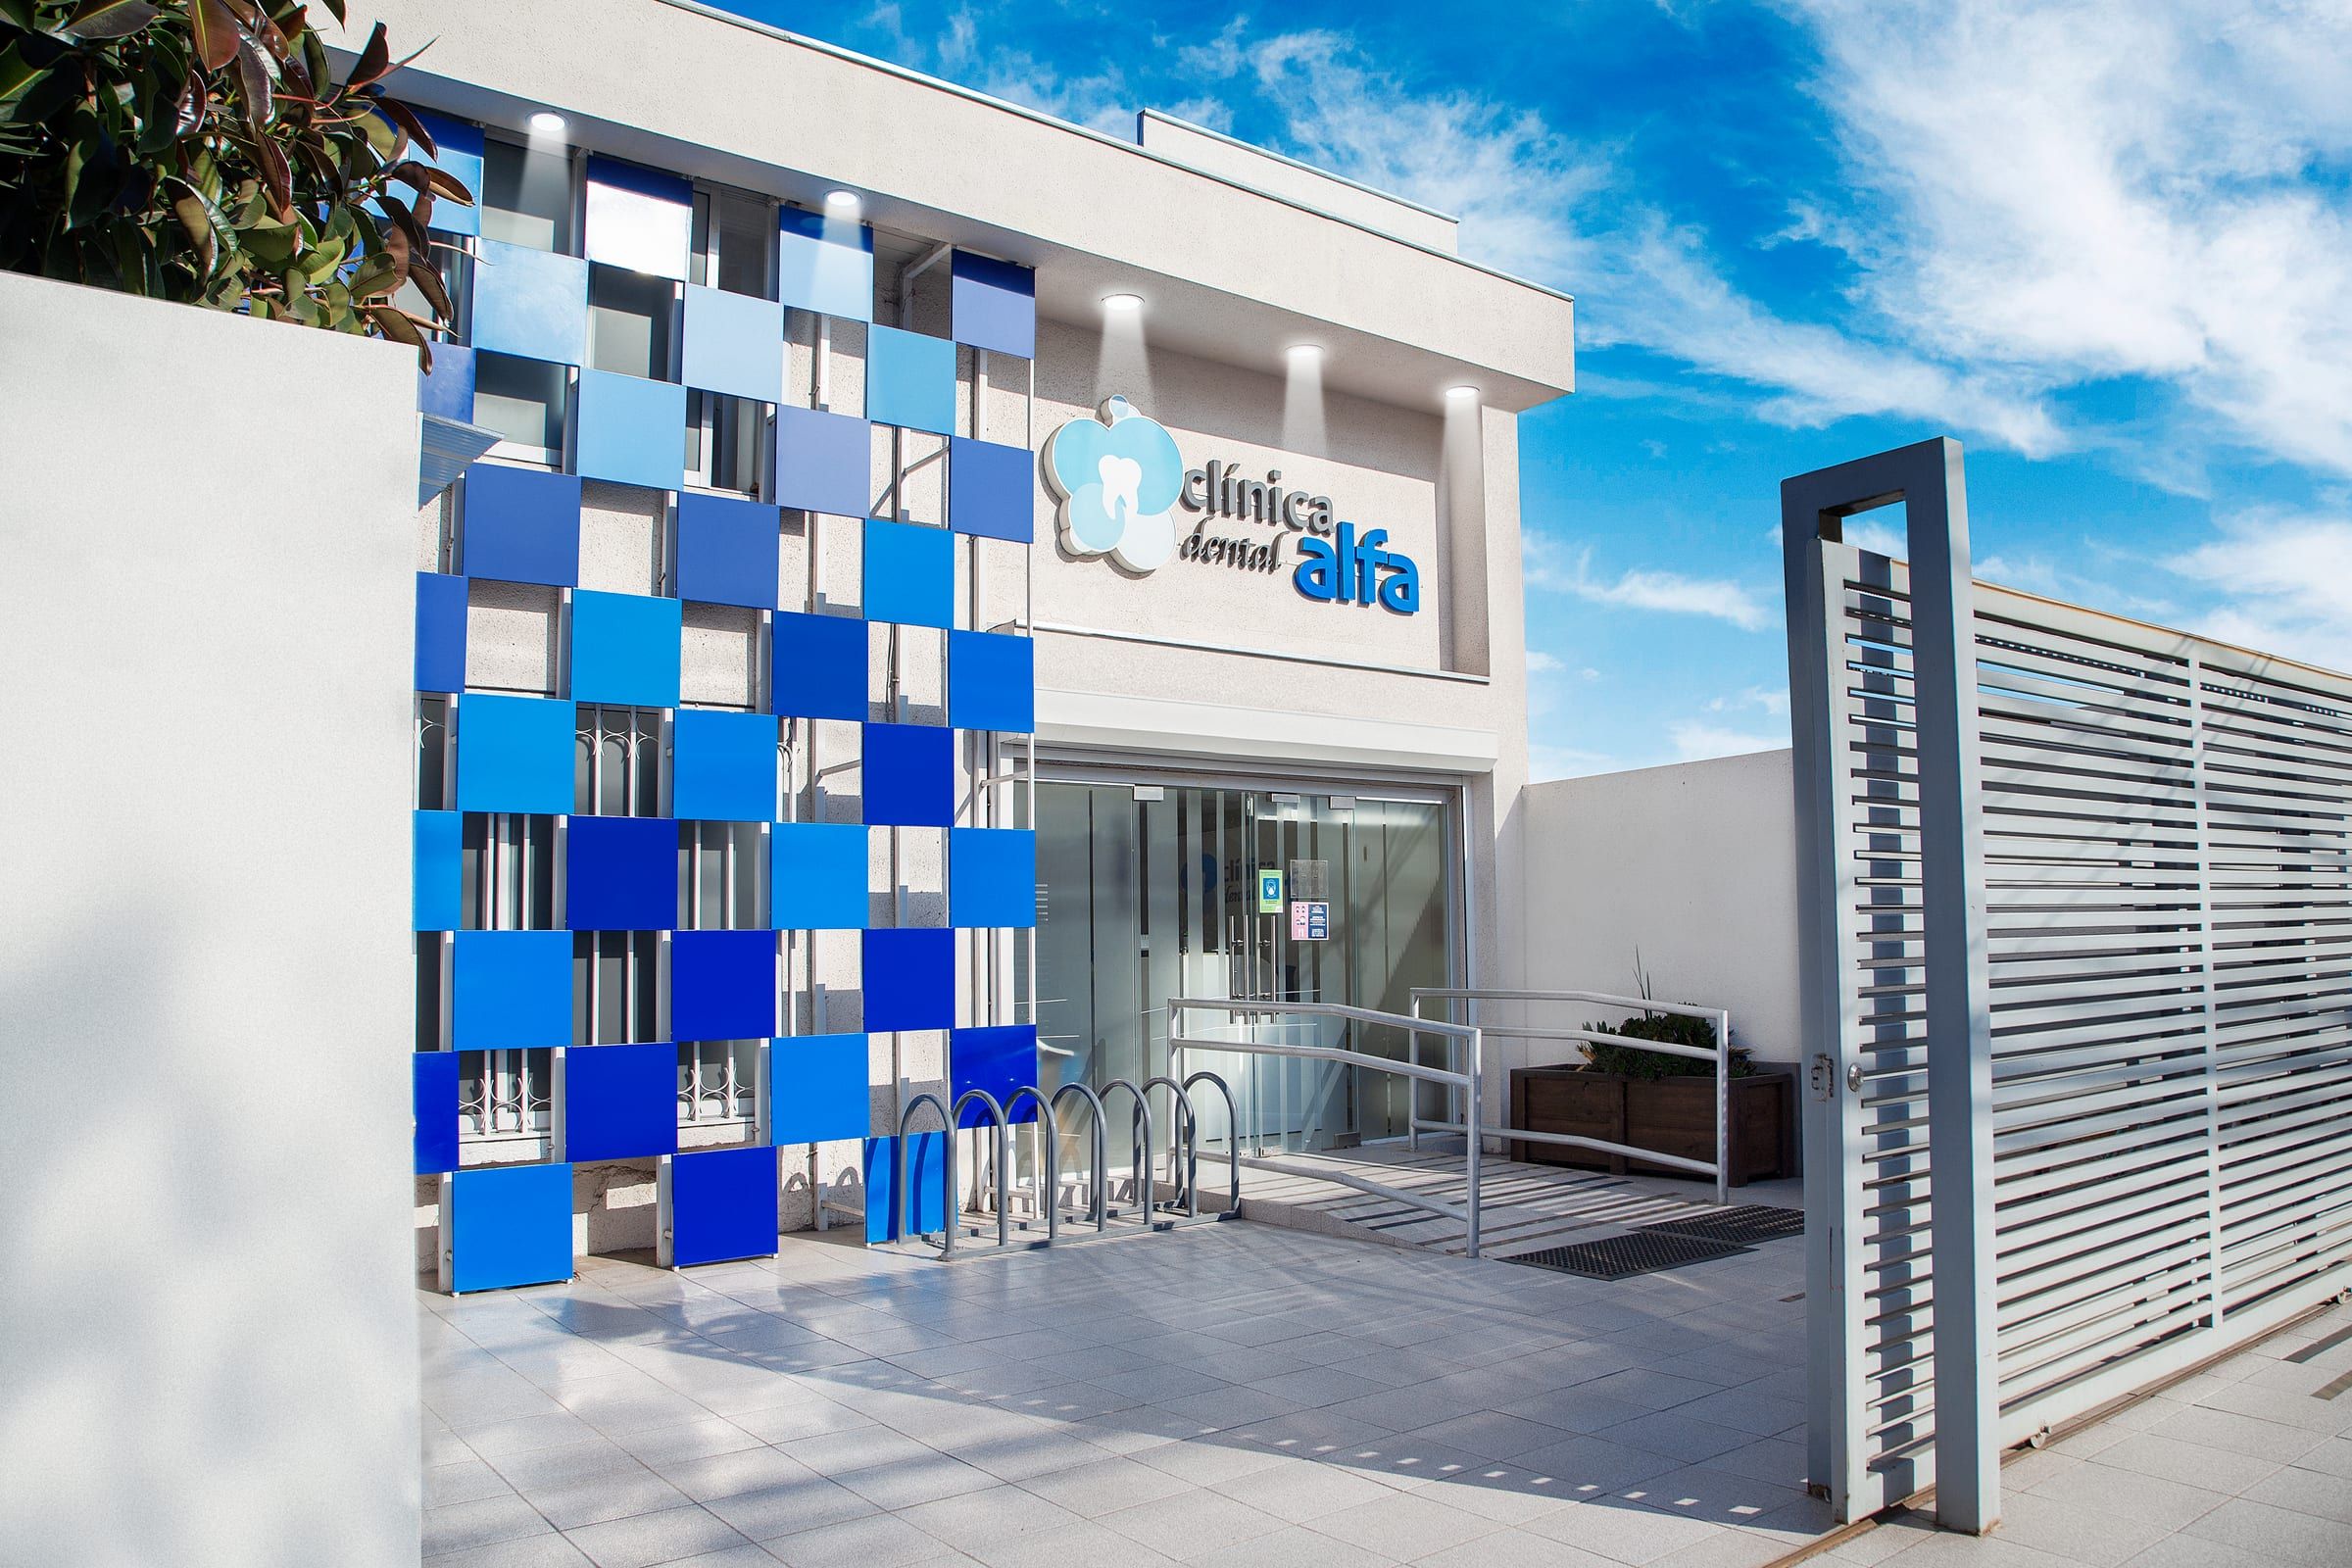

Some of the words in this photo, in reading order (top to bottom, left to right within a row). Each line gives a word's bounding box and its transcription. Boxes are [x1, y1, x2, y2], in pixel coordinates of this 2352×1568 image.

[1180, 460, 1335, 535] clínica
[1180, 515, 1290, 573] dental
[1295, 521, 1420, 613] alfa
